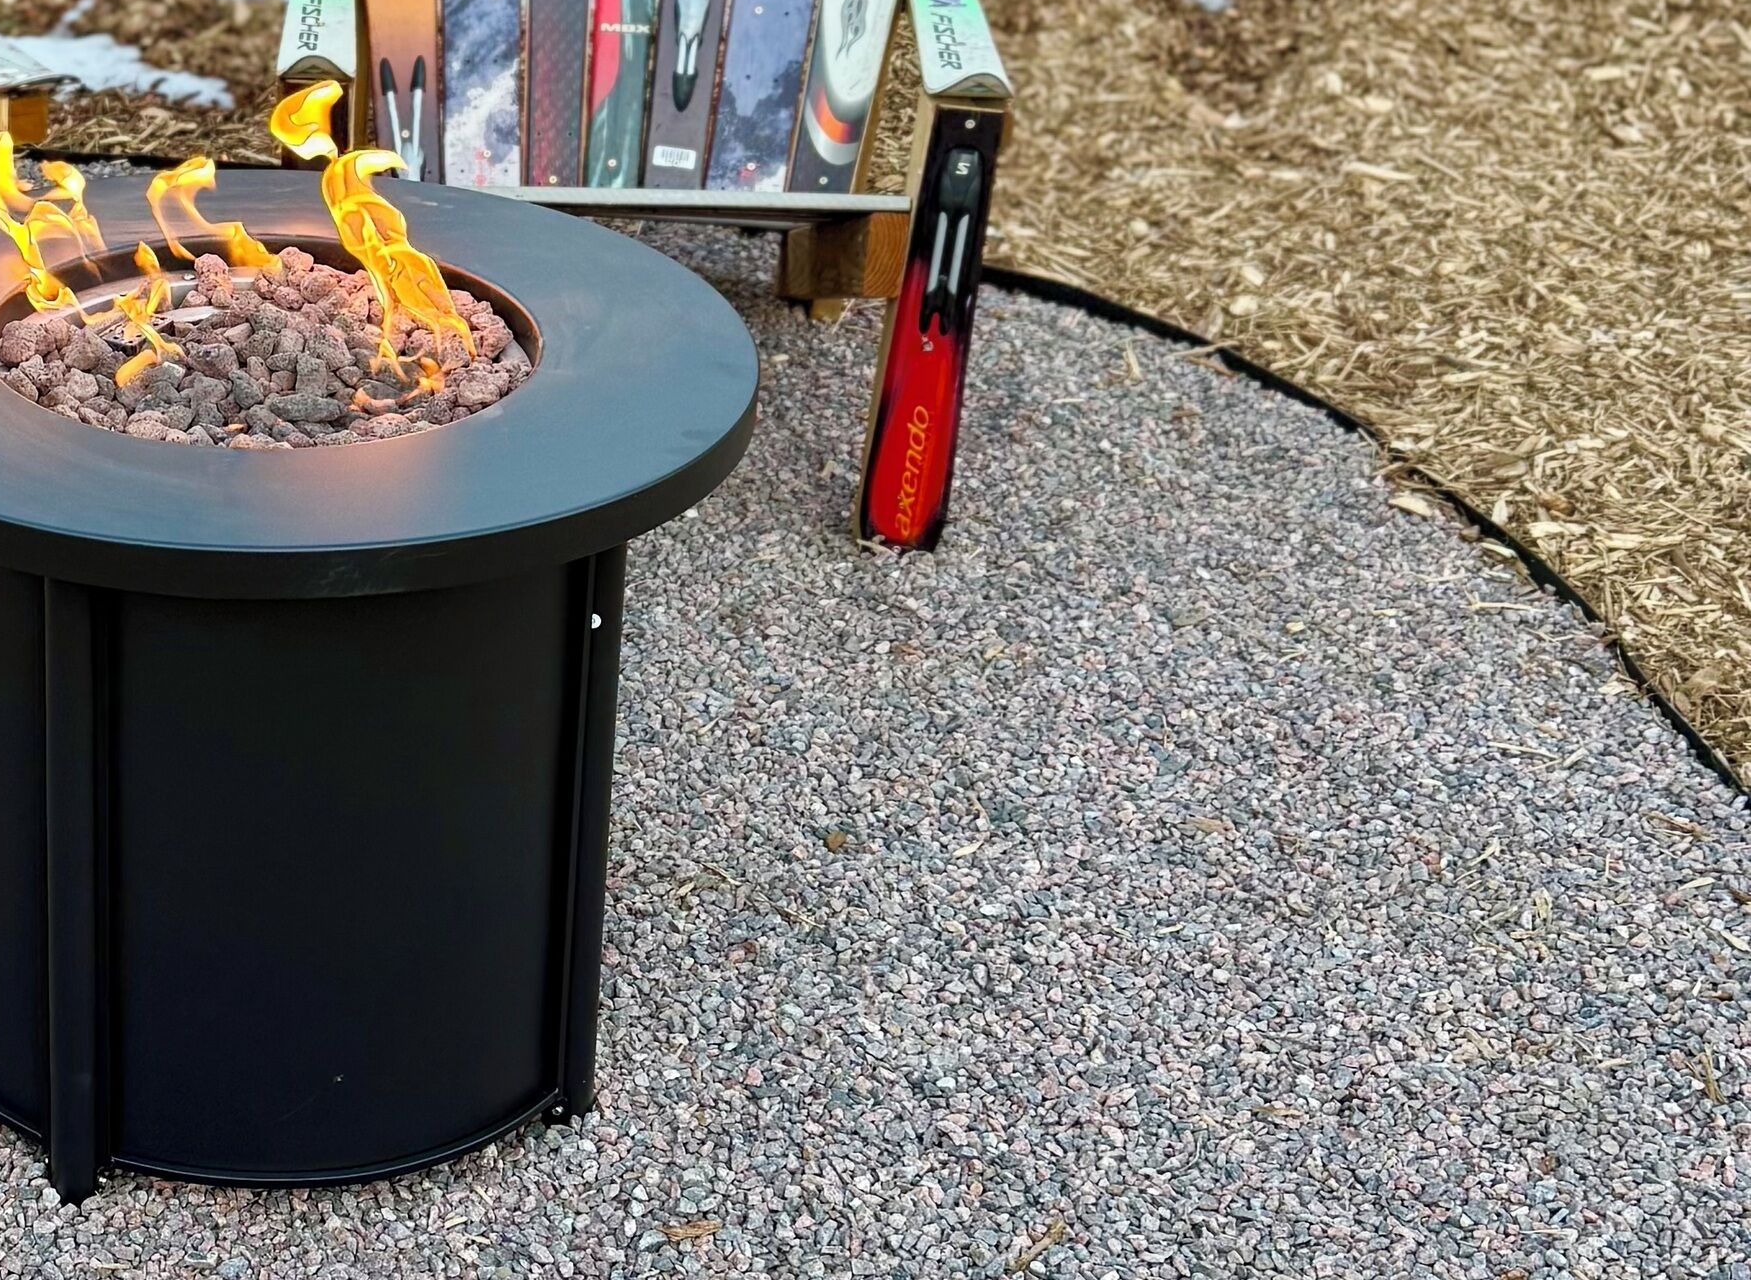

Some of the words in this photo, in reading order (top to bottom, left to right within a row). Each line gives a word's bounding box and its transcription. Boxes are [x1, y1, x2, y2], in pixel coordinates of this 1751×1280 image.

[600, 22, 651, 34] MBX
[930, 12, 962, 70] FISCHER
[895, 405, 930, 538] axendo
